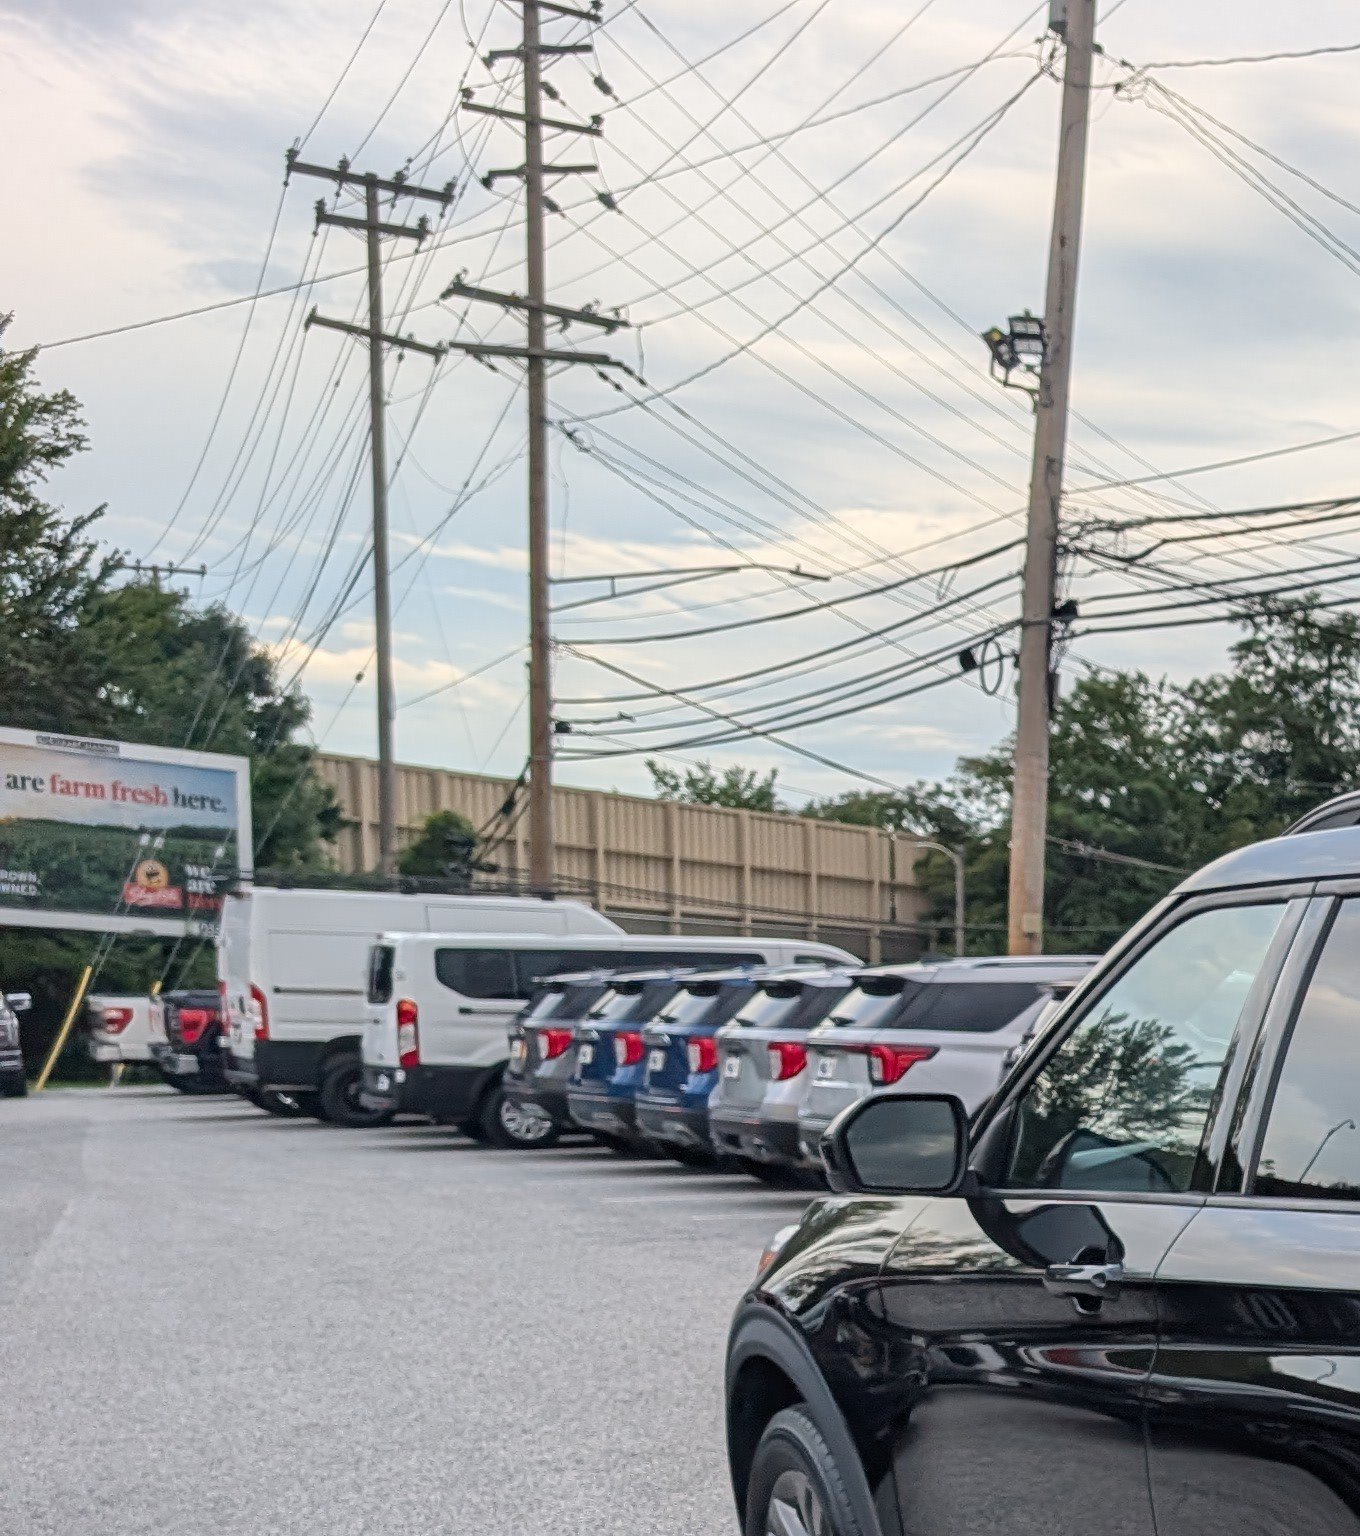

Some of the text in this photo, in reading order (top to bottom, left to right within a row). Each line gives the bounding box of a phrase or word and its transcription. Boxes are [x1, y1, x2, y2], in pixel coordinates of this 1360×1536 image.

[6, 773, 228, 813] are farm fresh here.
